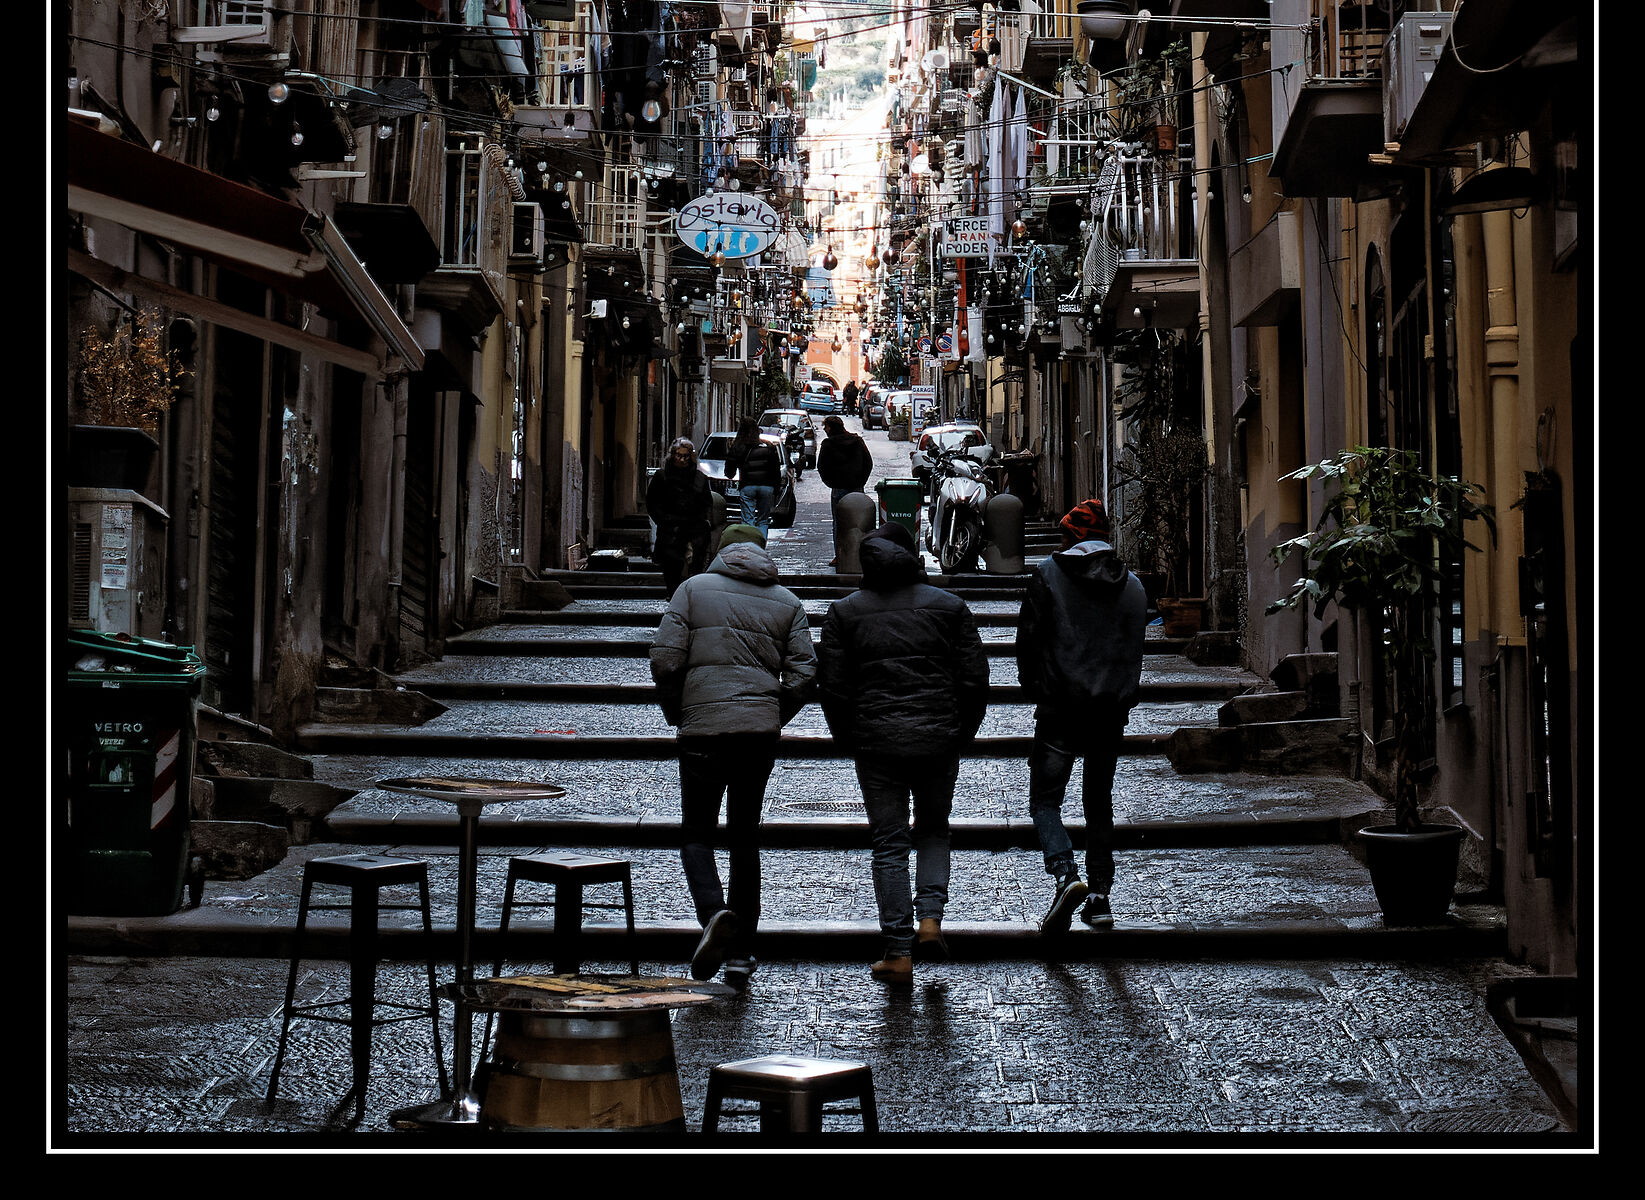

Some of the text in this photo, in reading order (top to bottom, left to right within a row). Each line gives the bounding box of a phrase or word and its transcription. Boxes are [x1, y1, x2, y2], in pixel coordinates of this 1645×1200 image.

[679, 197, 776, 231] Osteria
[945, 220, 989, 231] MERCE
[954, 232, 989, 241] RAN
[95, 722, 142, 732] VETRO
